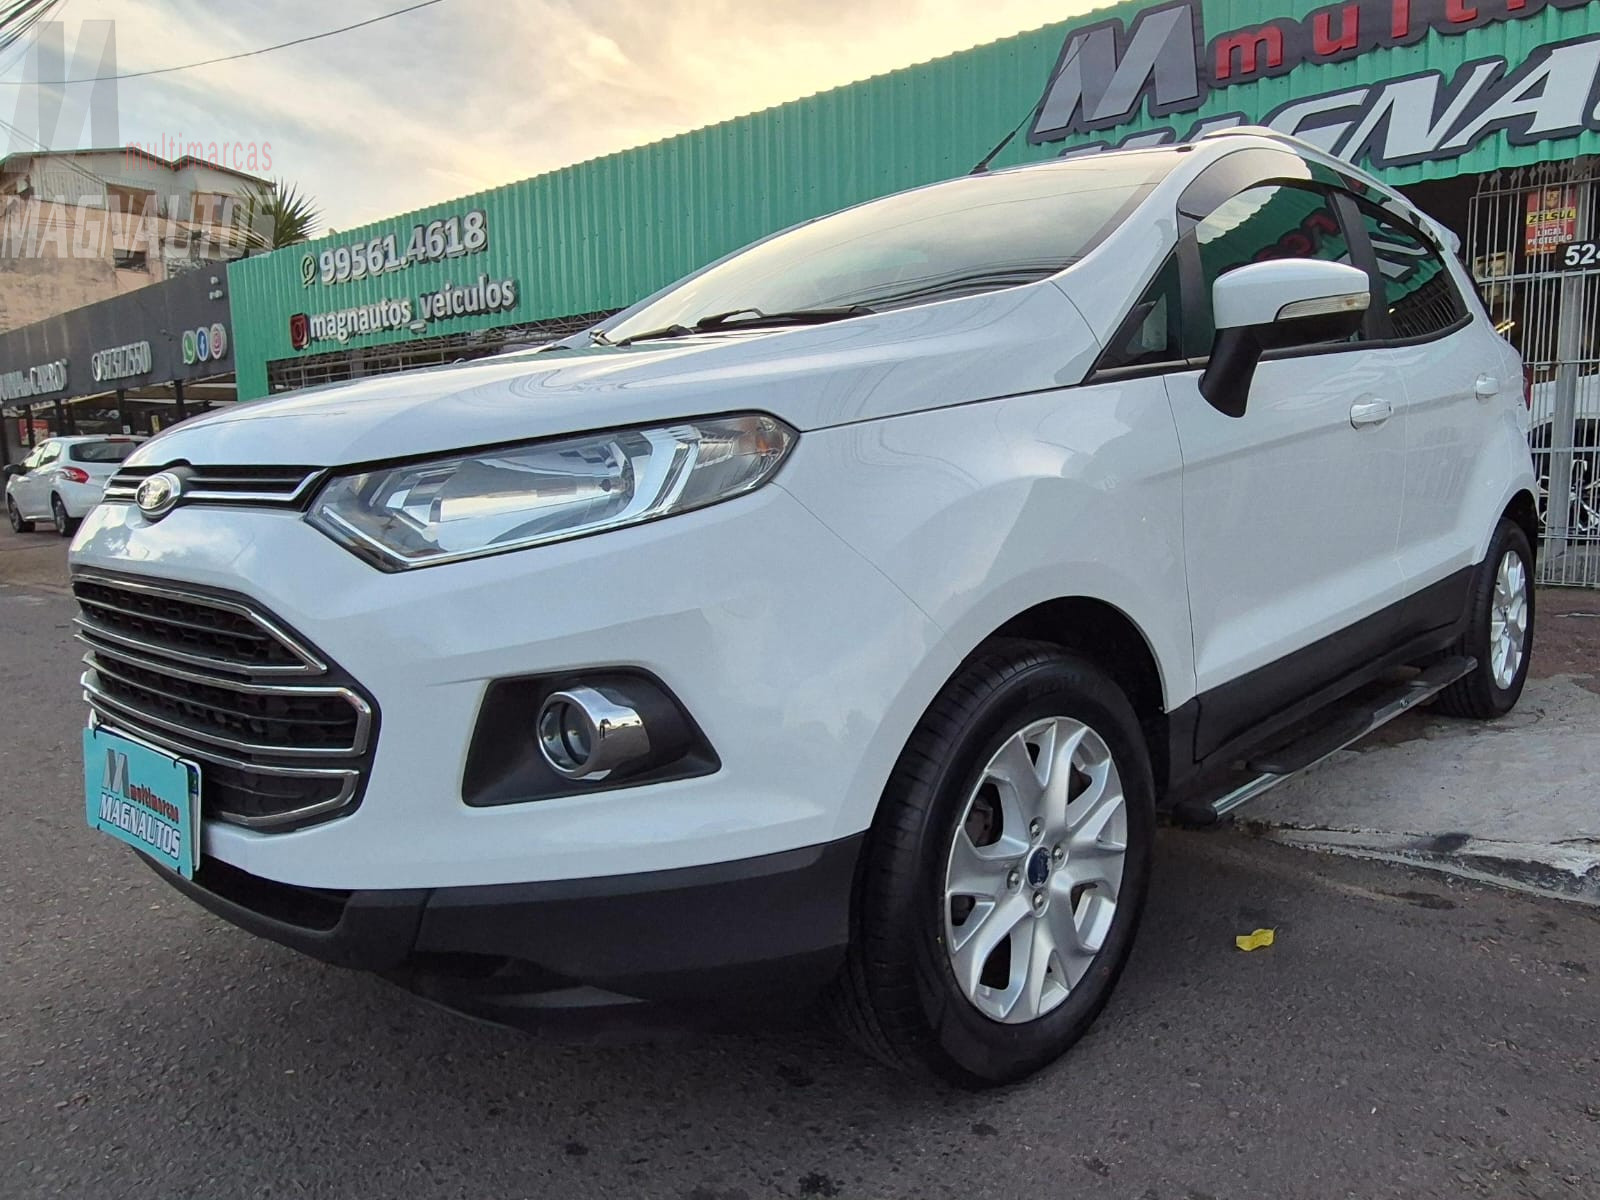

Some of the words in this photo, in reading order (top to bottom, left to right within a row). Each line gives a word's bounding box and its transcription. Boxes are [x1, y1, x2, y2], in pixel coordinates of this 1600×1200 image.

[319, 210, 486, 284] 99561.4618
[1564, 243, 1600, 266] 52
[99, 792, 181, 860] MAGNAUTOS
